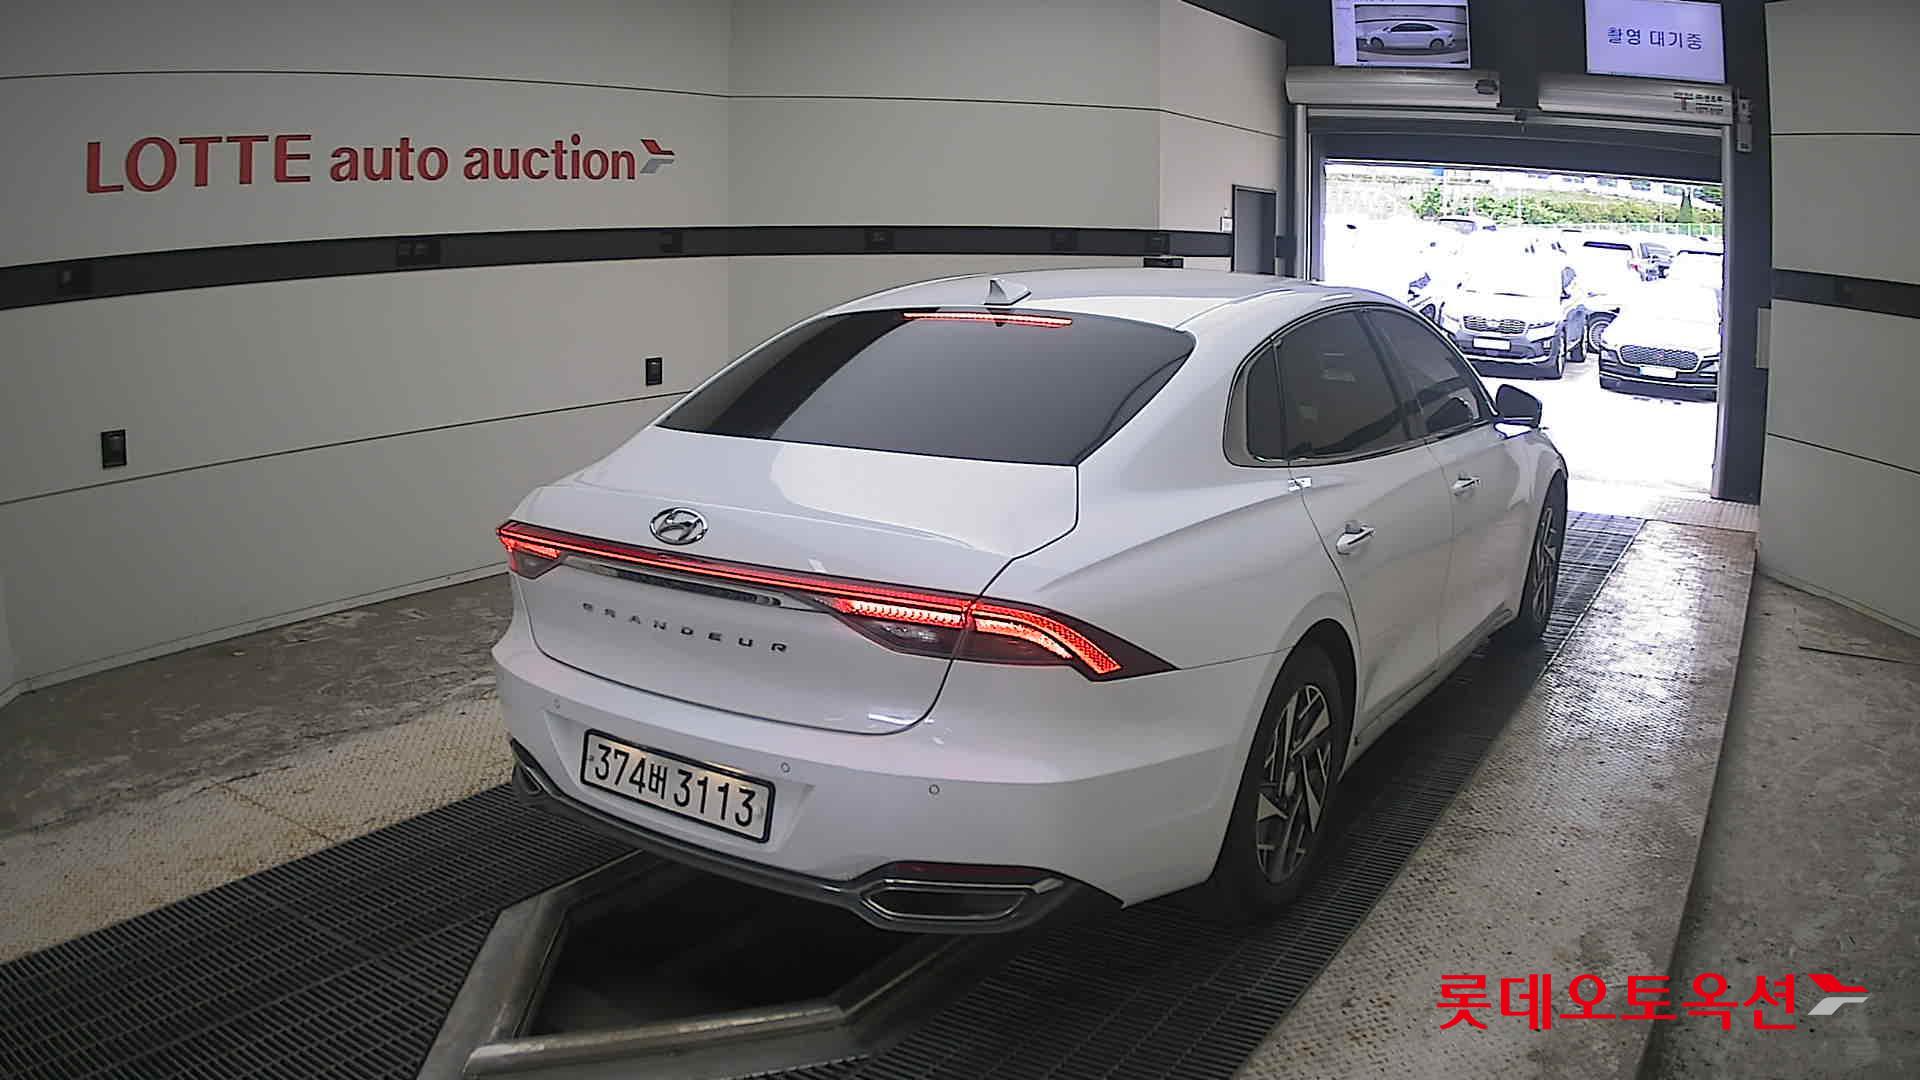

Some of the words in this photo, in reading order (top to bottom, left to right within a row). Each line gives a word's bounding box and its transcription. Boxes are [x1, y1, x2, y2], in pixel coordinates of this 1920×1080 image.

[1608, 26, 1641, 46] 촬영
[1650, 30, 1703, 50] 대기중
[86, 134, 311, 193] LOTTE
[330, 137, 448, 182] auto
[463, 133, 637, 182] auction
[582, 602, 788, 653] GRANDEUR
[594, 743, 668, 800] 374버
[673, 768, 756, 828] 3113
